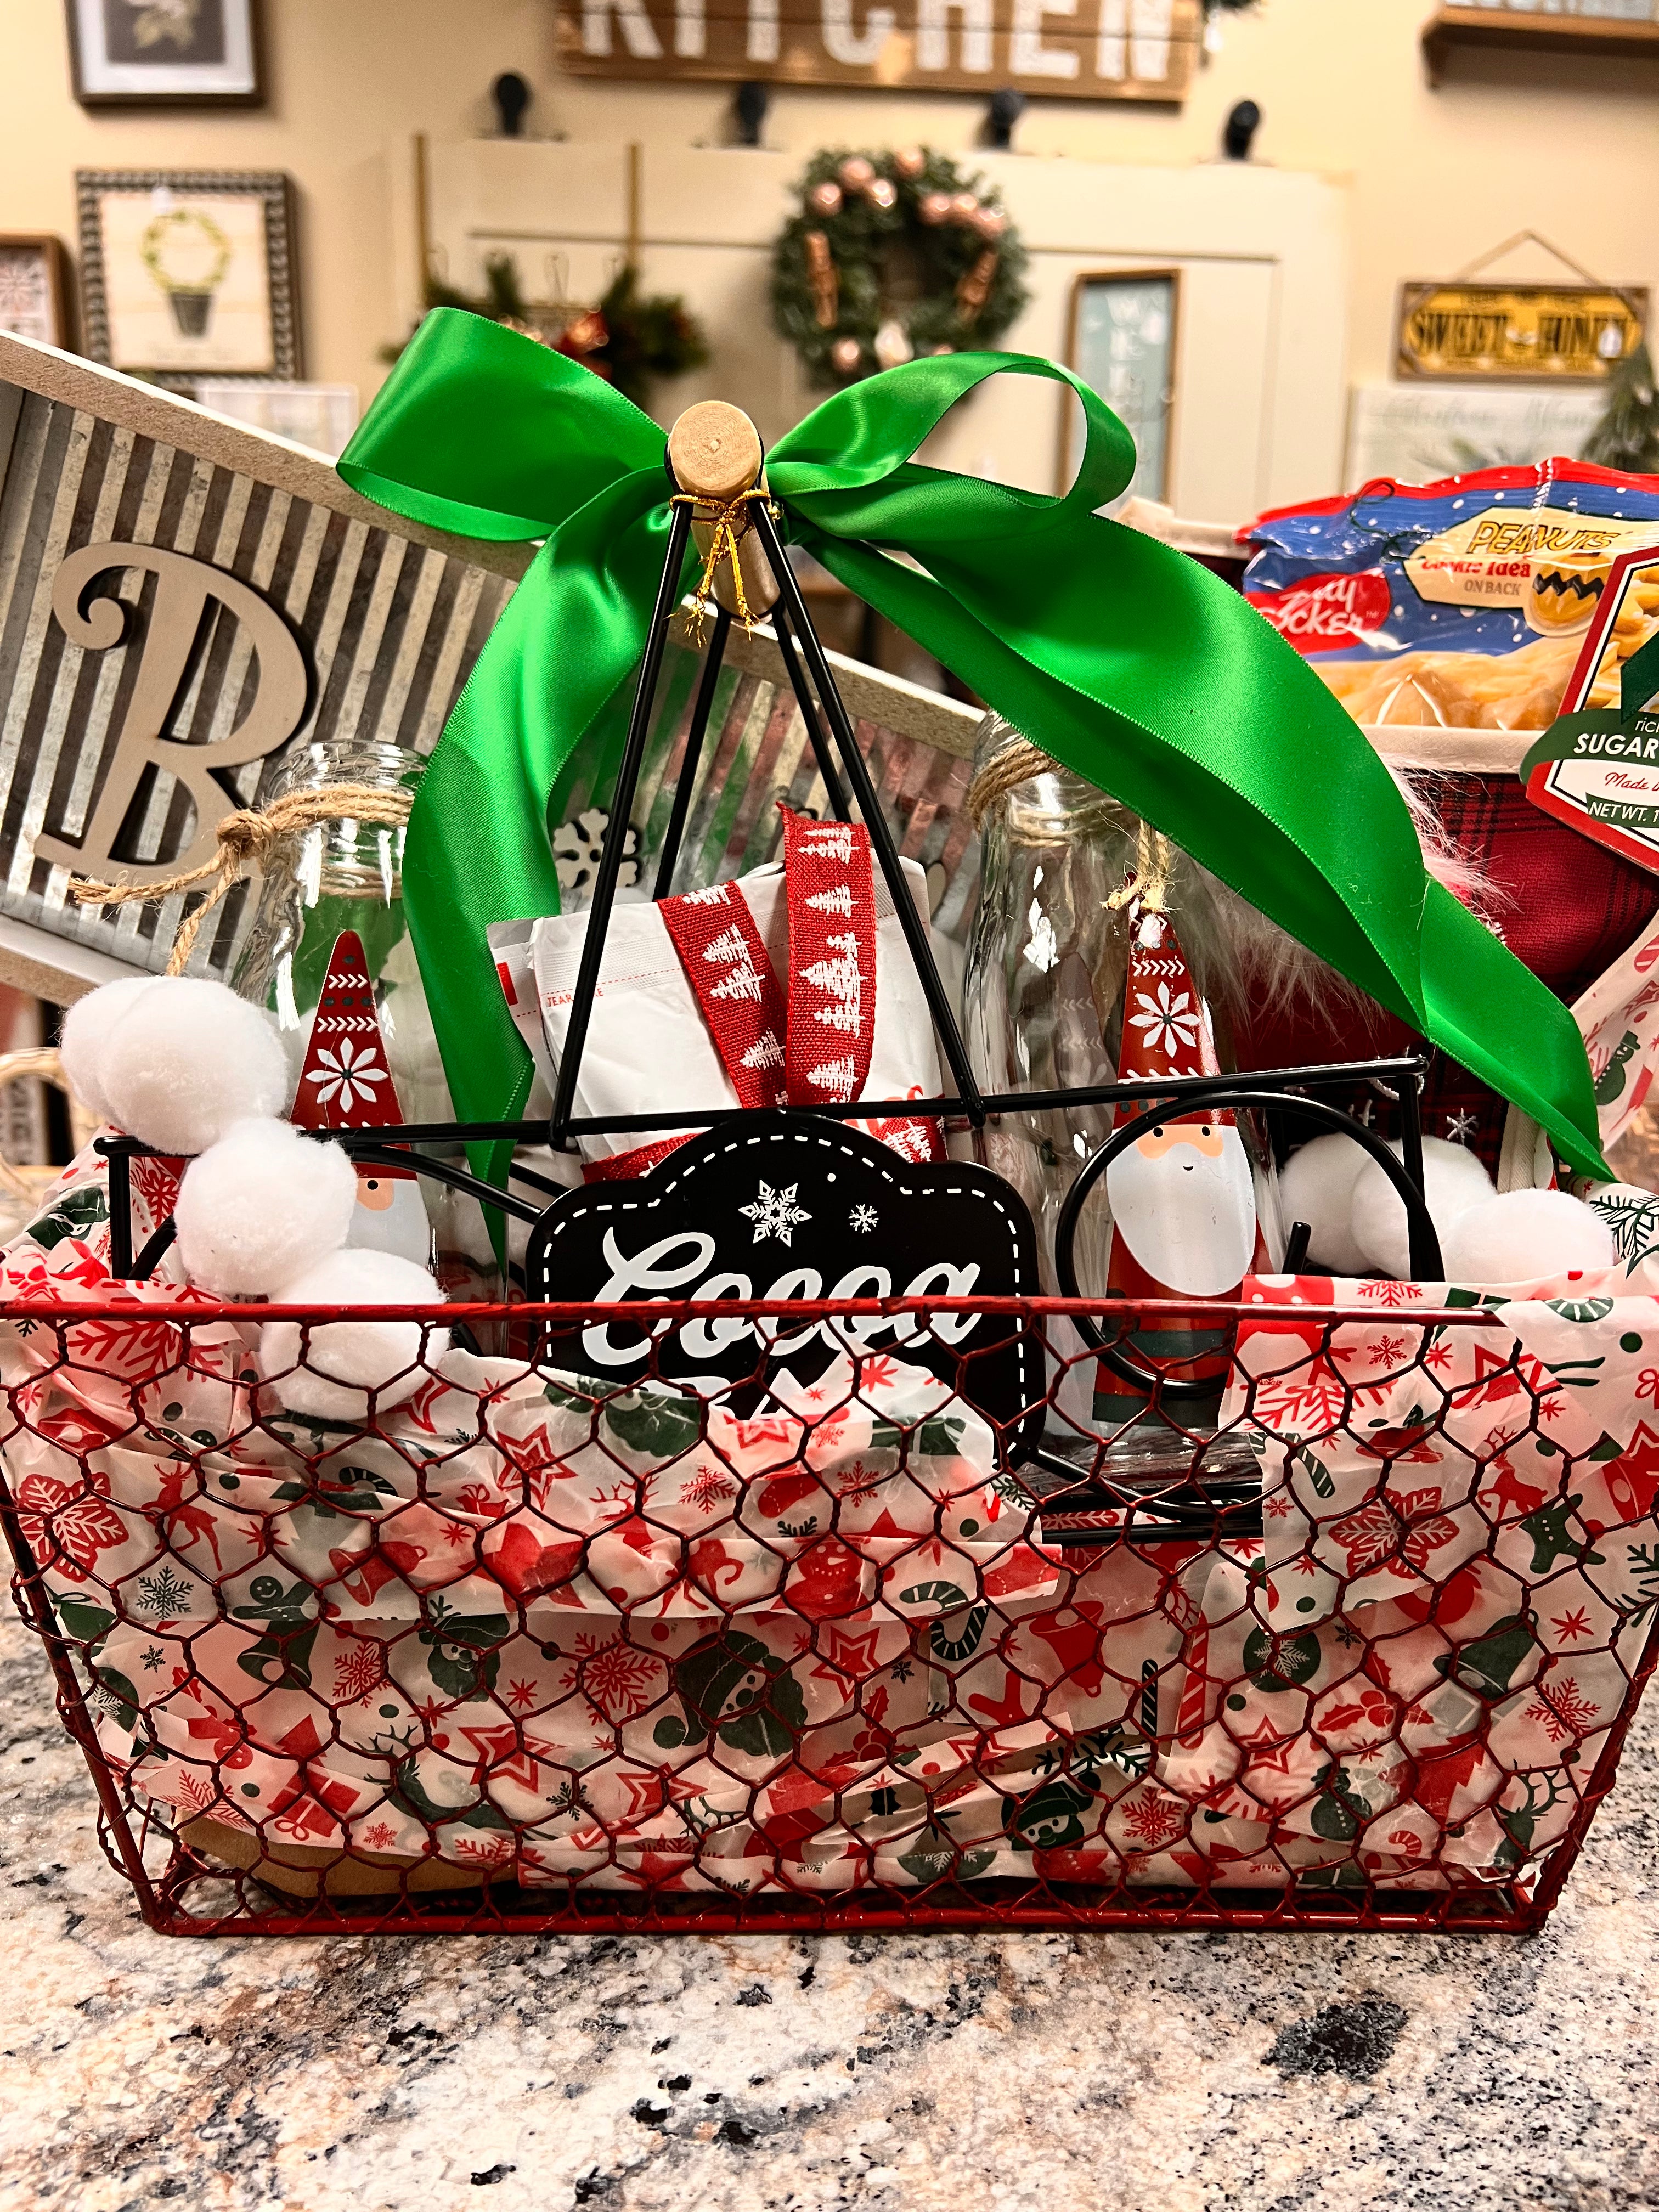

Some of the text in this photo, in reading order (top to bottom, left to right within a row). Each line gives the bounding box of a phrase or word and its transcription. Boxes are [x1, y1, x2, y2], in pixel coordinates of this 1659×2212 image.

[1465, 520, 1621, 554] PEANUTS
[1464, 579, 1522, 596] ON BACK
[33, 541, 308, 893] B
[1573, 733, 1659, 759] SUGAR
[1604, 772, 1649, 790] Made
[1589, 801, 1621, 818] NET
[1622, 805, 1648, 822] WT.
[547, 994, 574, 1007] TEAR
[582, 1226, 983, 1365] Cocoa
